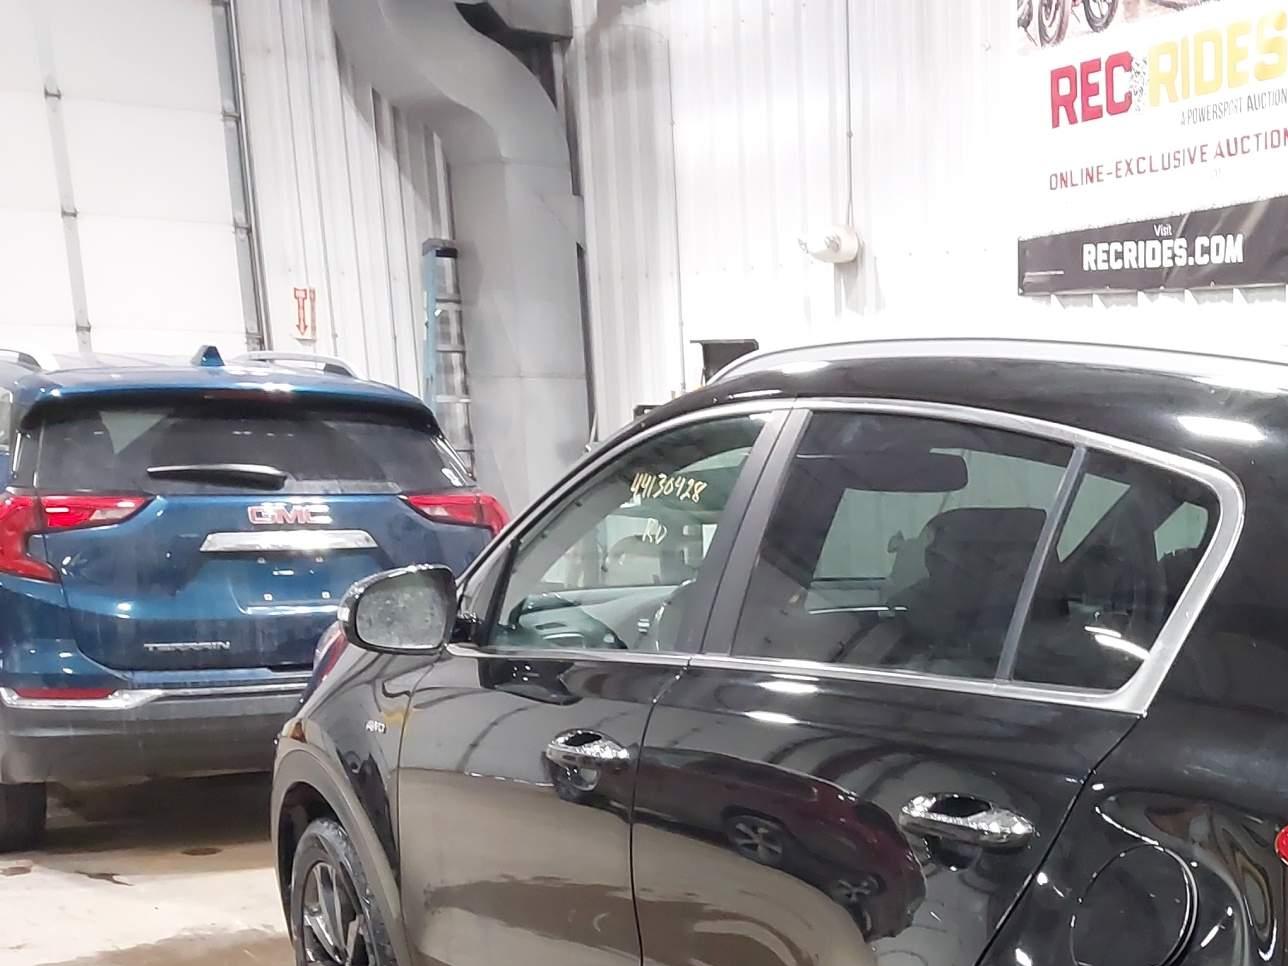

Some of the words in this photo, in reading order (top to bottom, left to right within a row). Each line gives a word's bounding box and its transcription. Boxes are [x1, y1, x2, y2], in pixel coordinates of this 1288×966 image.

[1050, 51, 1133, 129] REC
[1150, 9, 1288, 107] RIDES
[1247, 87, 1288, 113] AUCTION
[1049, 143, 1208, 191] ONLINE-EXCLUSIVE
[1153, 223, 1173, 238] Visit
[1082, 234, 1244, 272] RECRIDES.COM
[630, 472, 708, 503] 44130428
[247, 502, 333, 525] GMC
